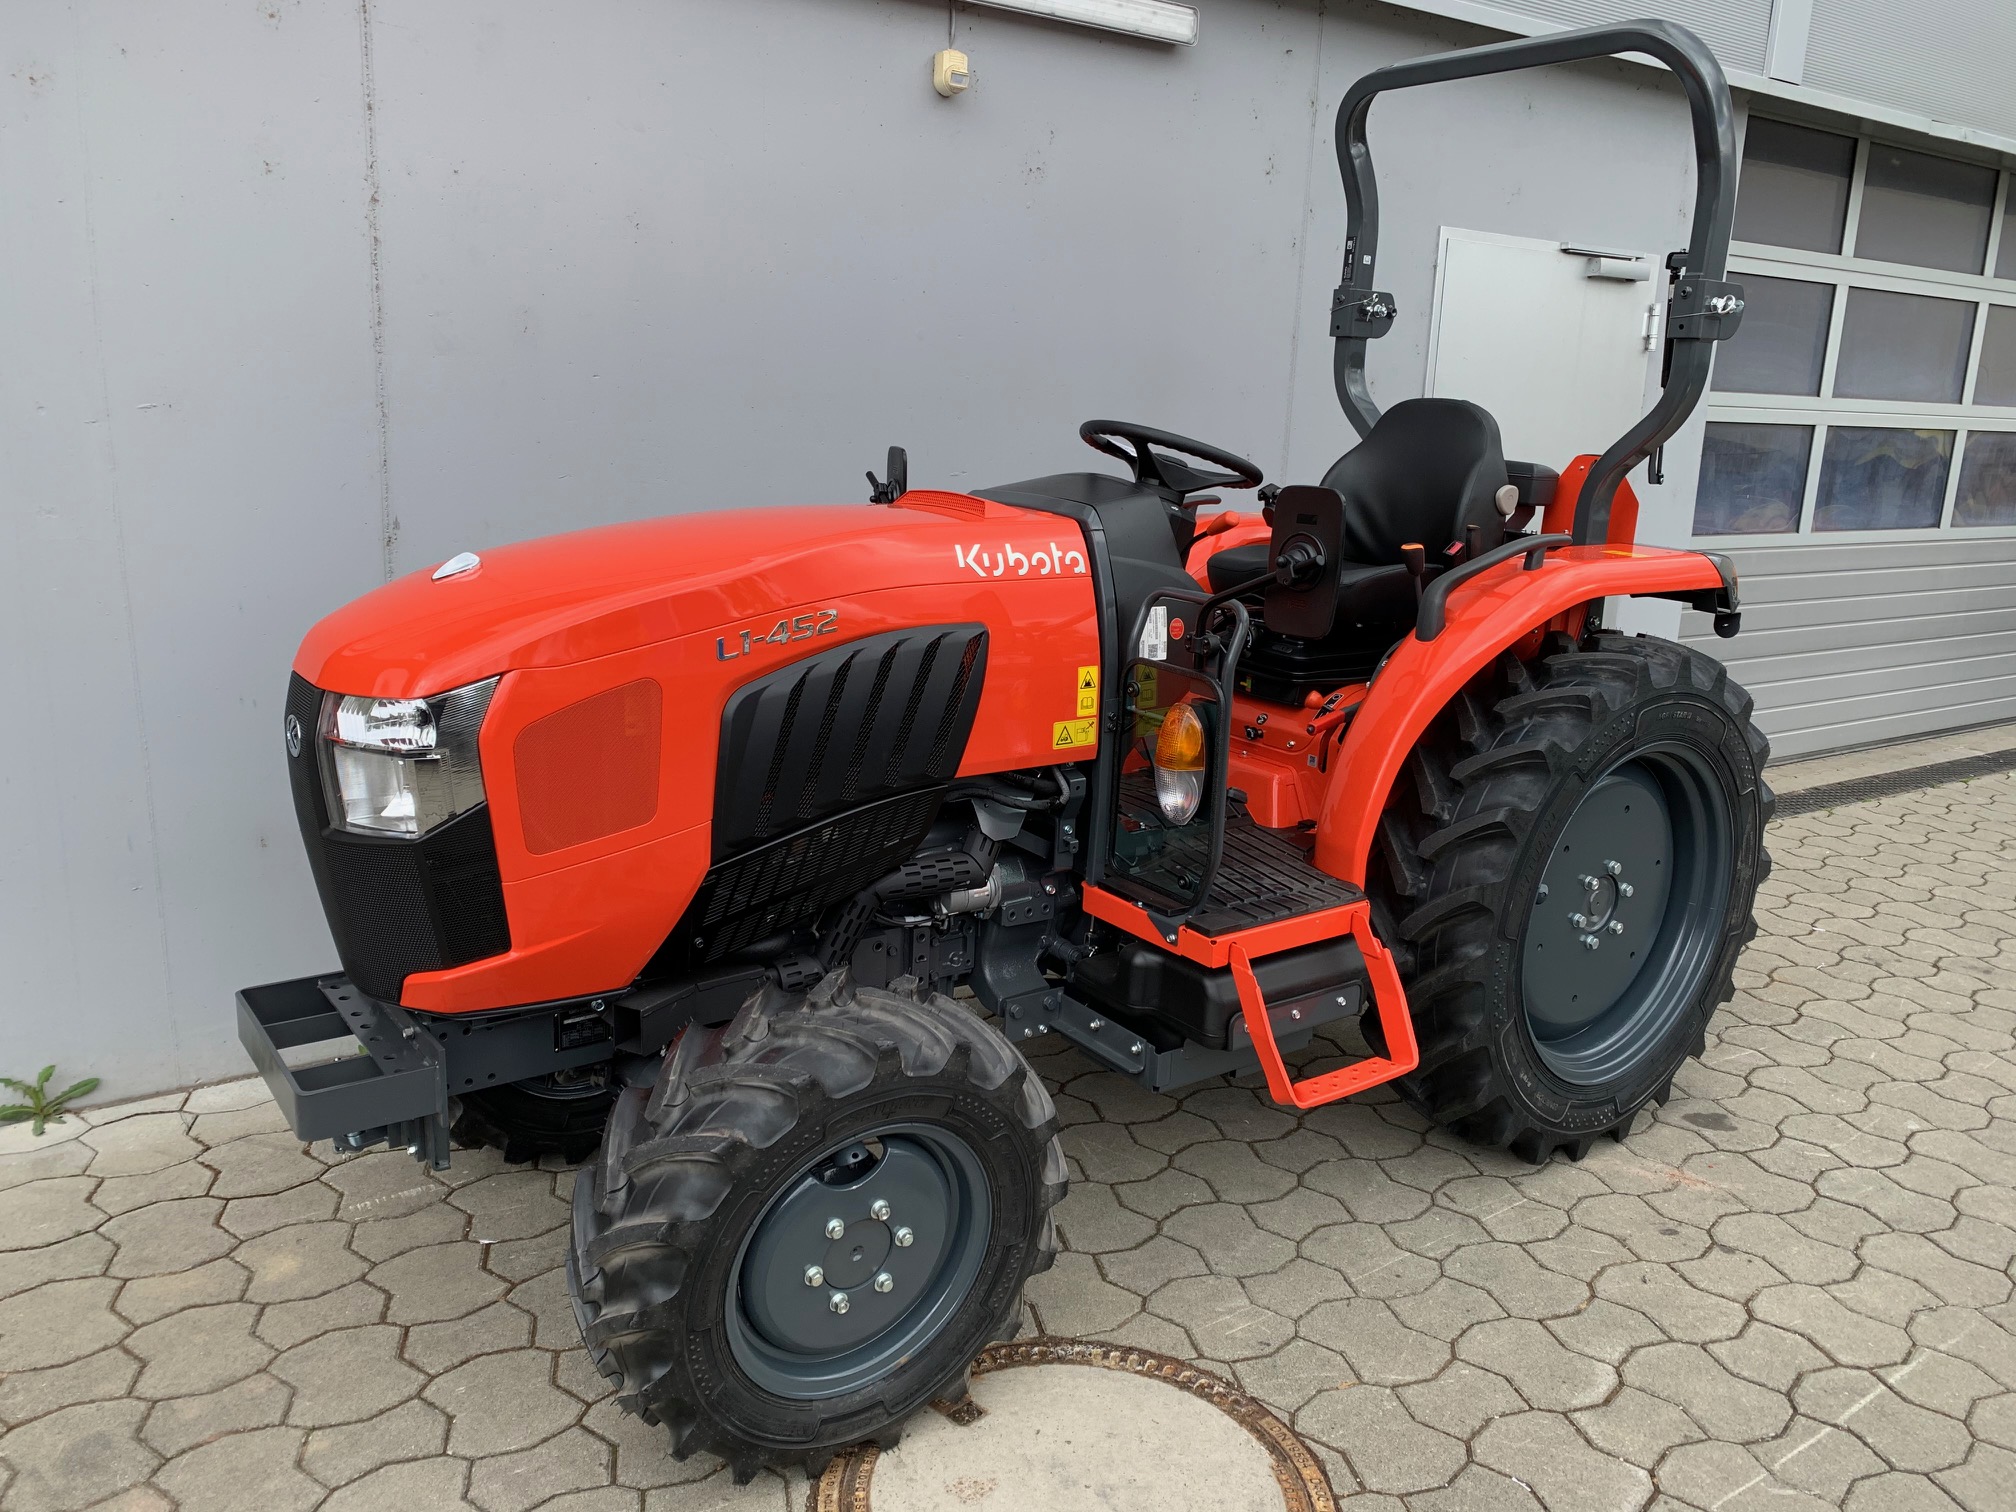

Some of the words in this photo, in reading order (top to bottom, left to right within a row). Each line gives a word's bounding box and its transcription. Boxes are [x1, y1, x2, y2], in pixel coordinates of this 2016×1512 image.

[954, 542, 1087, 577] Kubota
[716, 609, 838, 661] L1-452
[1270, 1426, 1287, 1442] DIN
[826, 1464, 840, 1487] GUSS
